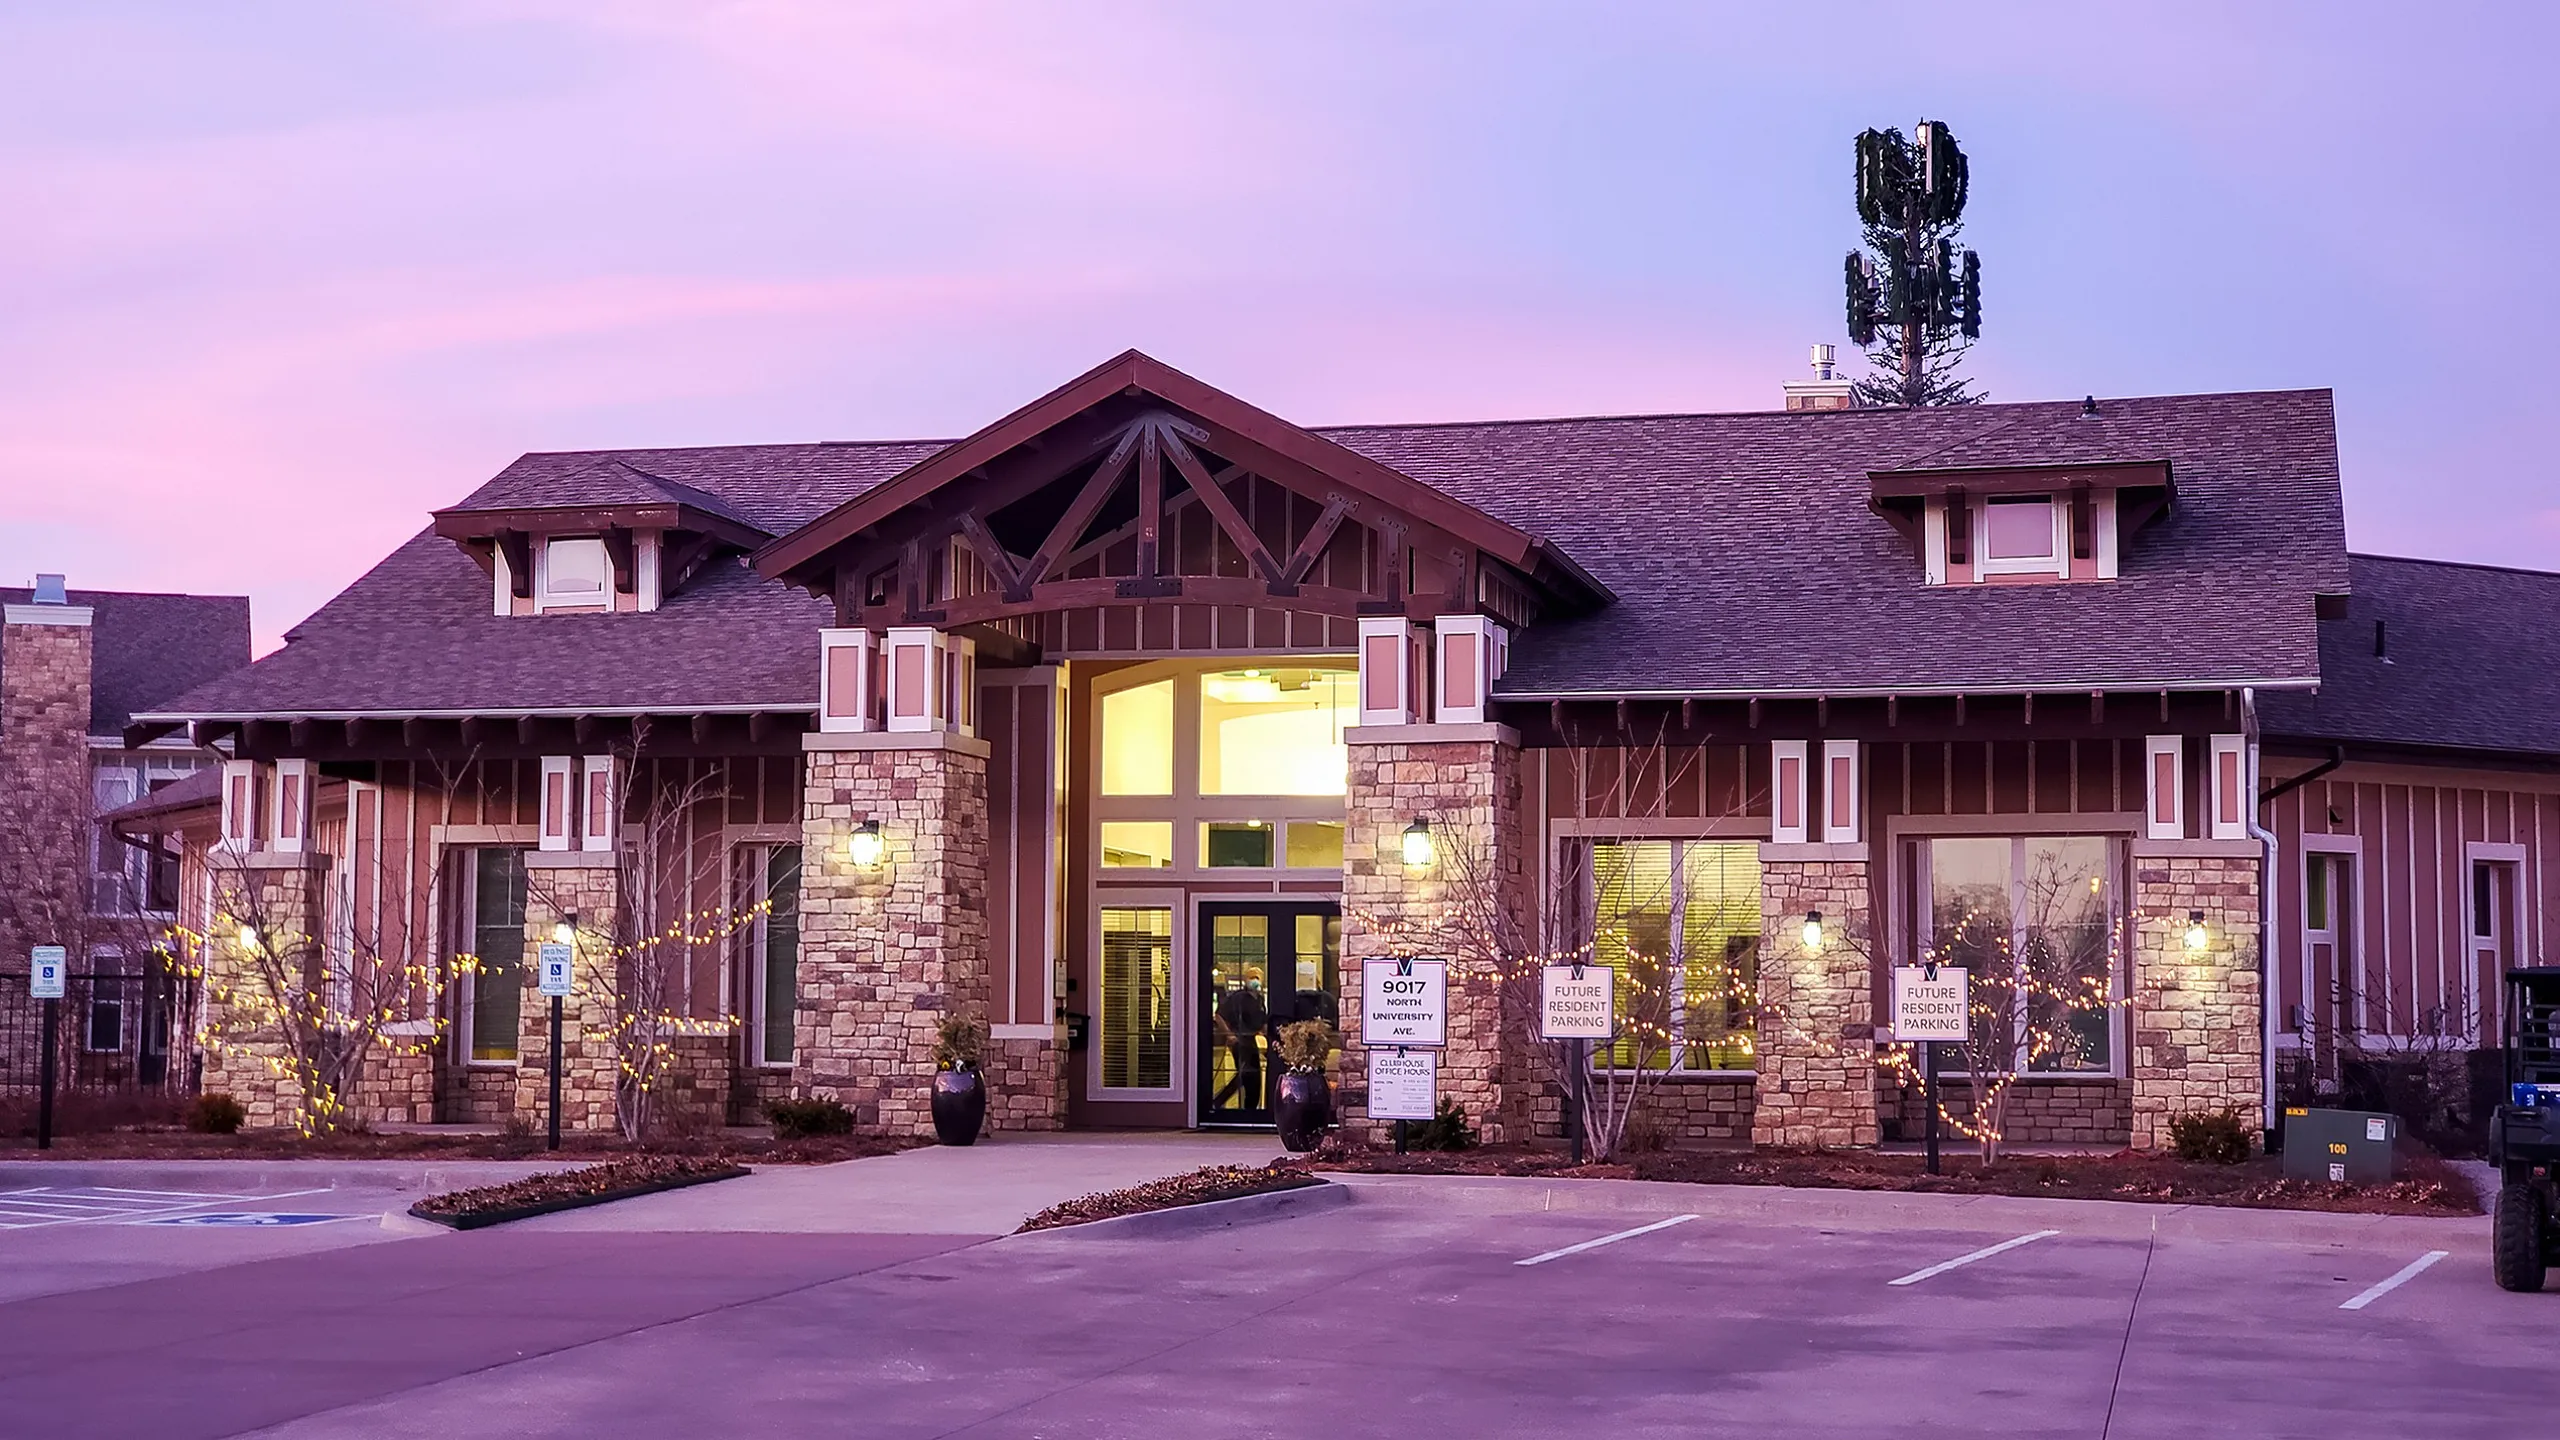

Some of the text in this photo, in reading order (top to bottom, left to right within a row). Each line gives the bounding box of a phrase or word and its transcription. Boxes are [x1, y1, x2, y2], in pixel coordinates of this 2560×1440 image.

[1383, 980, 1426, 994] 9017
[1555, 986, 1601, 997] FUTURE
[1907, 987, 1956, 999] FUTURE
[1387, 998, 1422, 1006] NORTH
[1549, 1001, 1607, 1012] RESIDENT
[1901, 1003, 1962, 1014] RESIDENT
[1372, 1012, 1433, 1020] UNIVERSITY
[1551, 1016, 1604, 1027] PARKING
[1904, 1018, 1960, 1030] PARKING
[1375, 1067, 1401, 1075] OFFICE
[2328, 1143, 2347, 1154] 100
